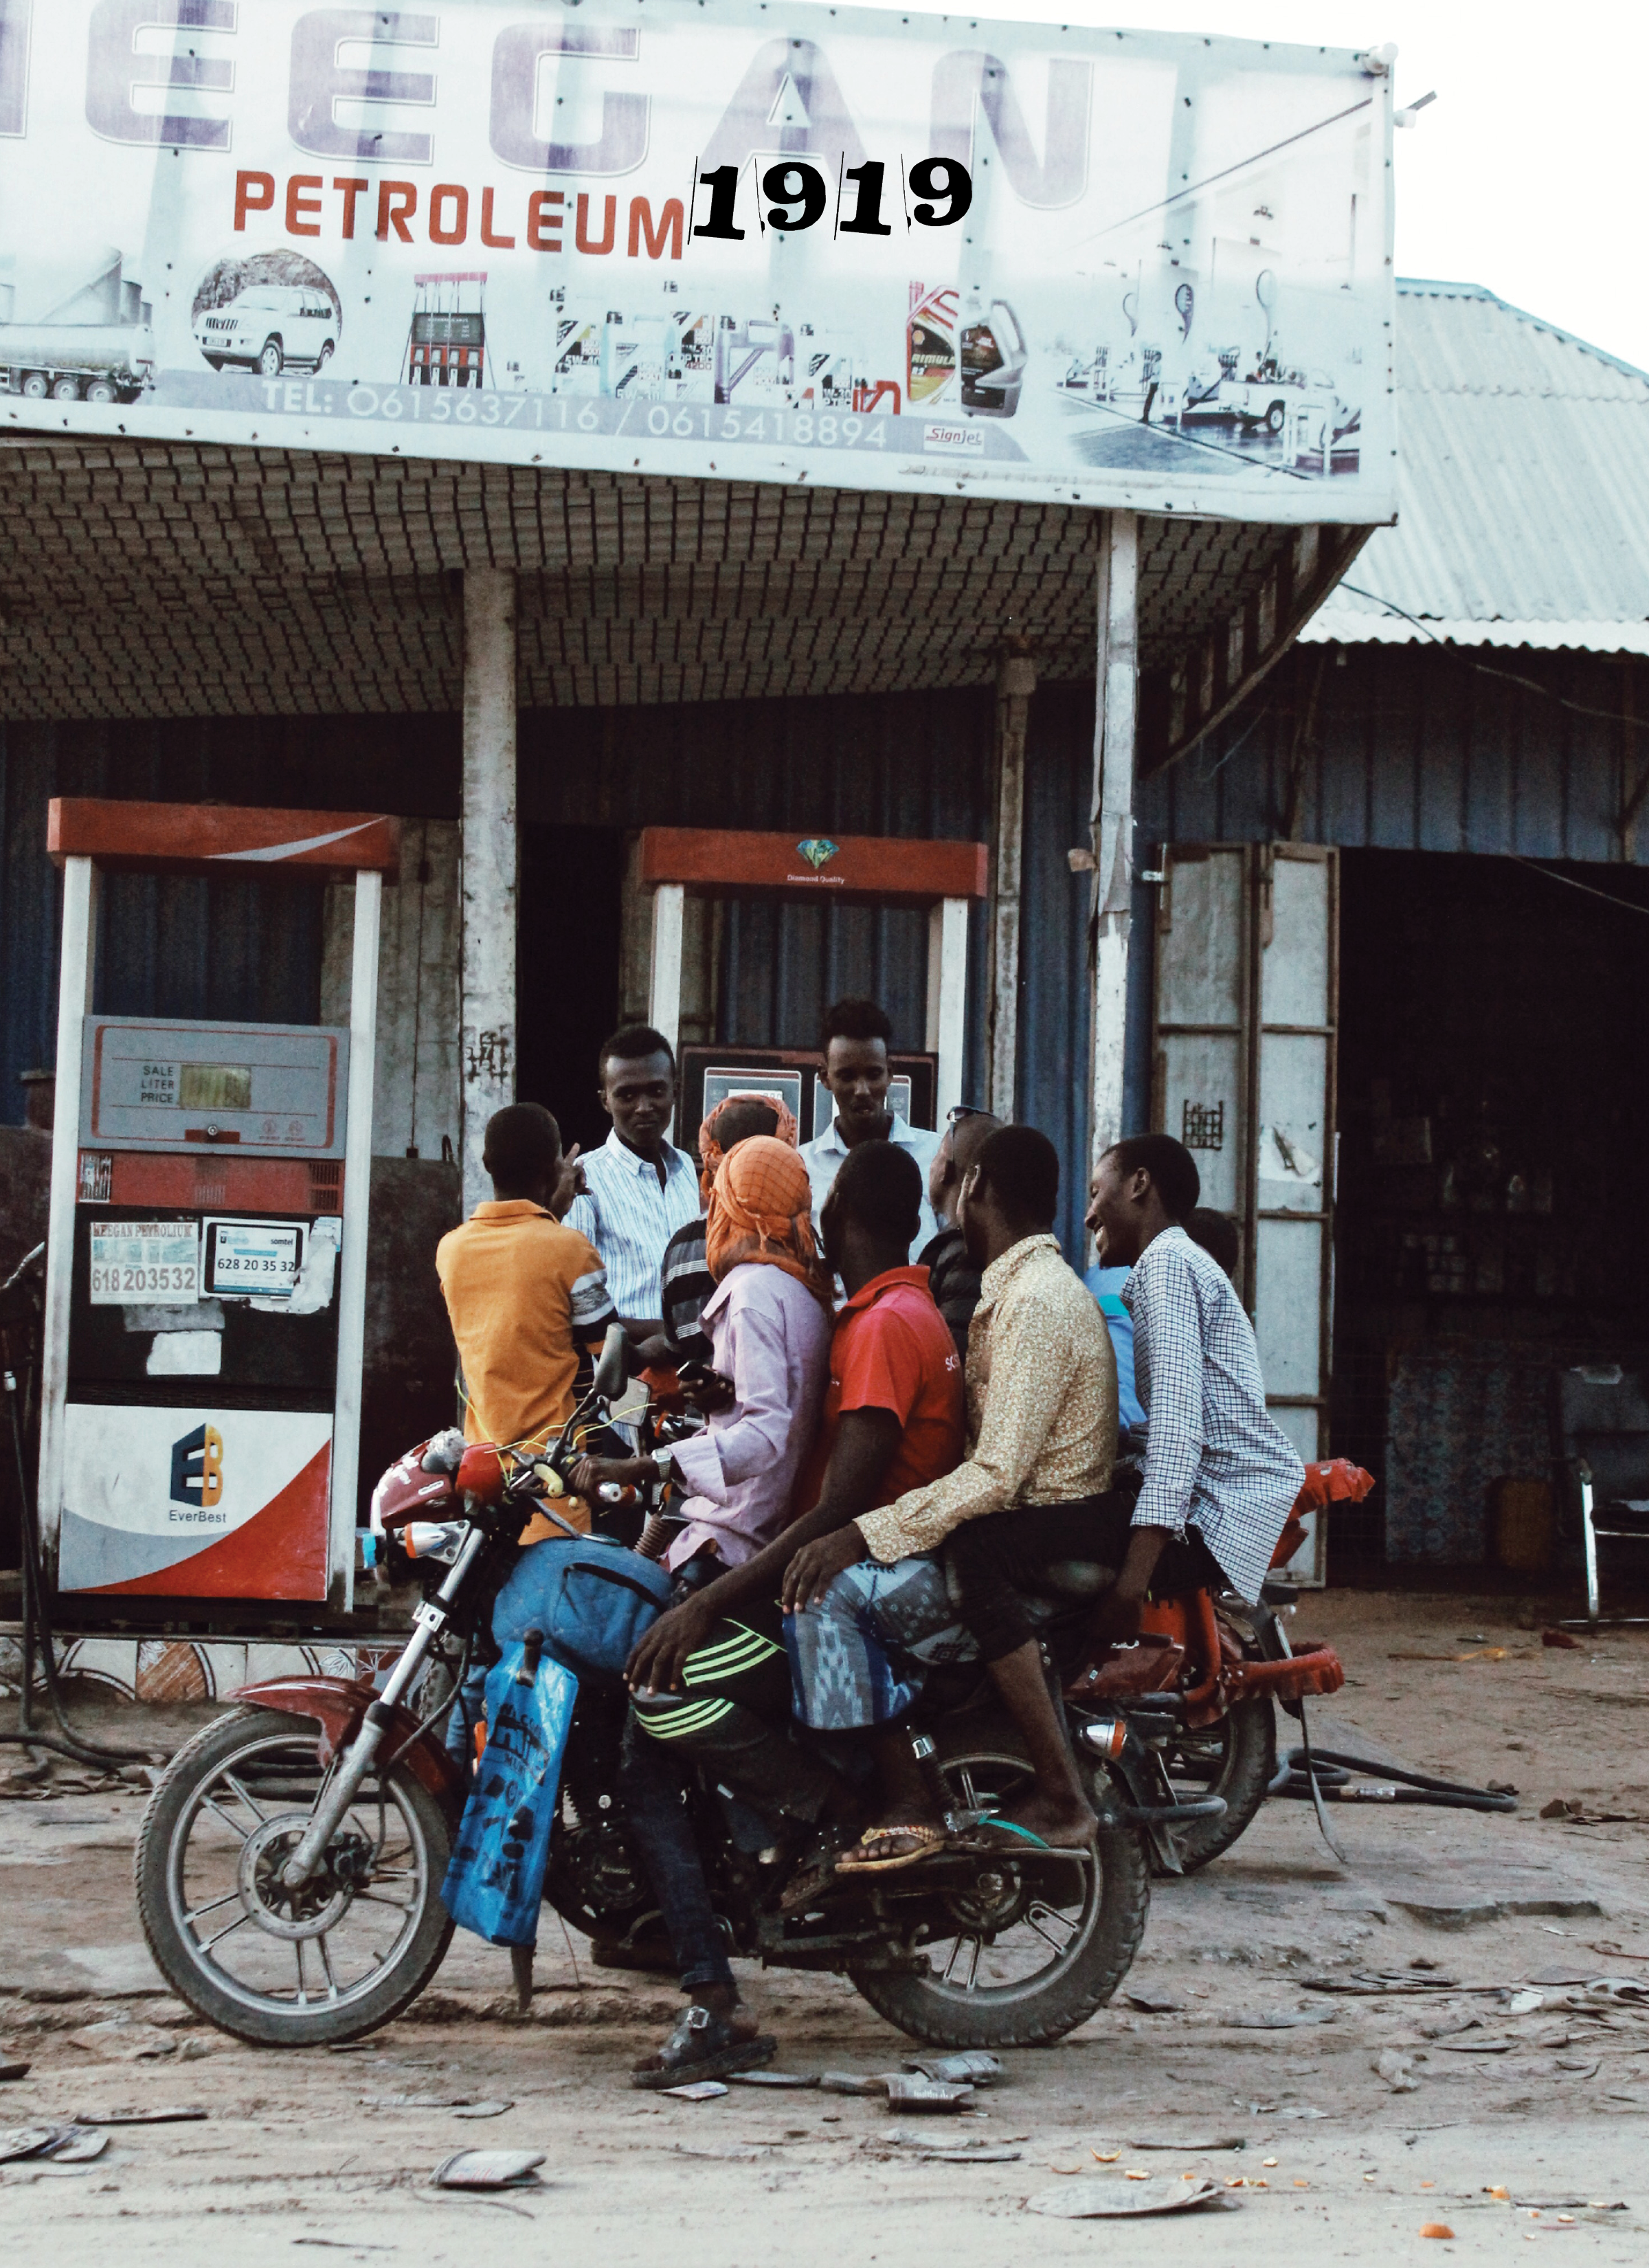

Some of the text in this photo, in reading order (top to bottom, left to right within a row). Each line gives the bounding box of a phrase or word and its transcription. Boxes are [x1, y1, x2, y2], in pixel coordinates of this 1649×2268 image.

[0, 0, 1094, 210] EEGAN
[234, 170, 683, 260] PETROLEUM
[262, 381, 333, 413] TEL:
[347, 386, 599, 431] 0615637116
[647, 405, 887, 447] 0615418894
[925, 427, 983, 445] Signjet
[787, 874, 844, 885] Diamond Quality
[143, 1065, 174, 1076] SALE
[141, 1078, 175, 1089] LITER
[141, 1092, 174, 1103] PRICE
[218, 1258, 295, 1272] 628 20 35 32
[169, 1510, 227, 1524] EverBest
